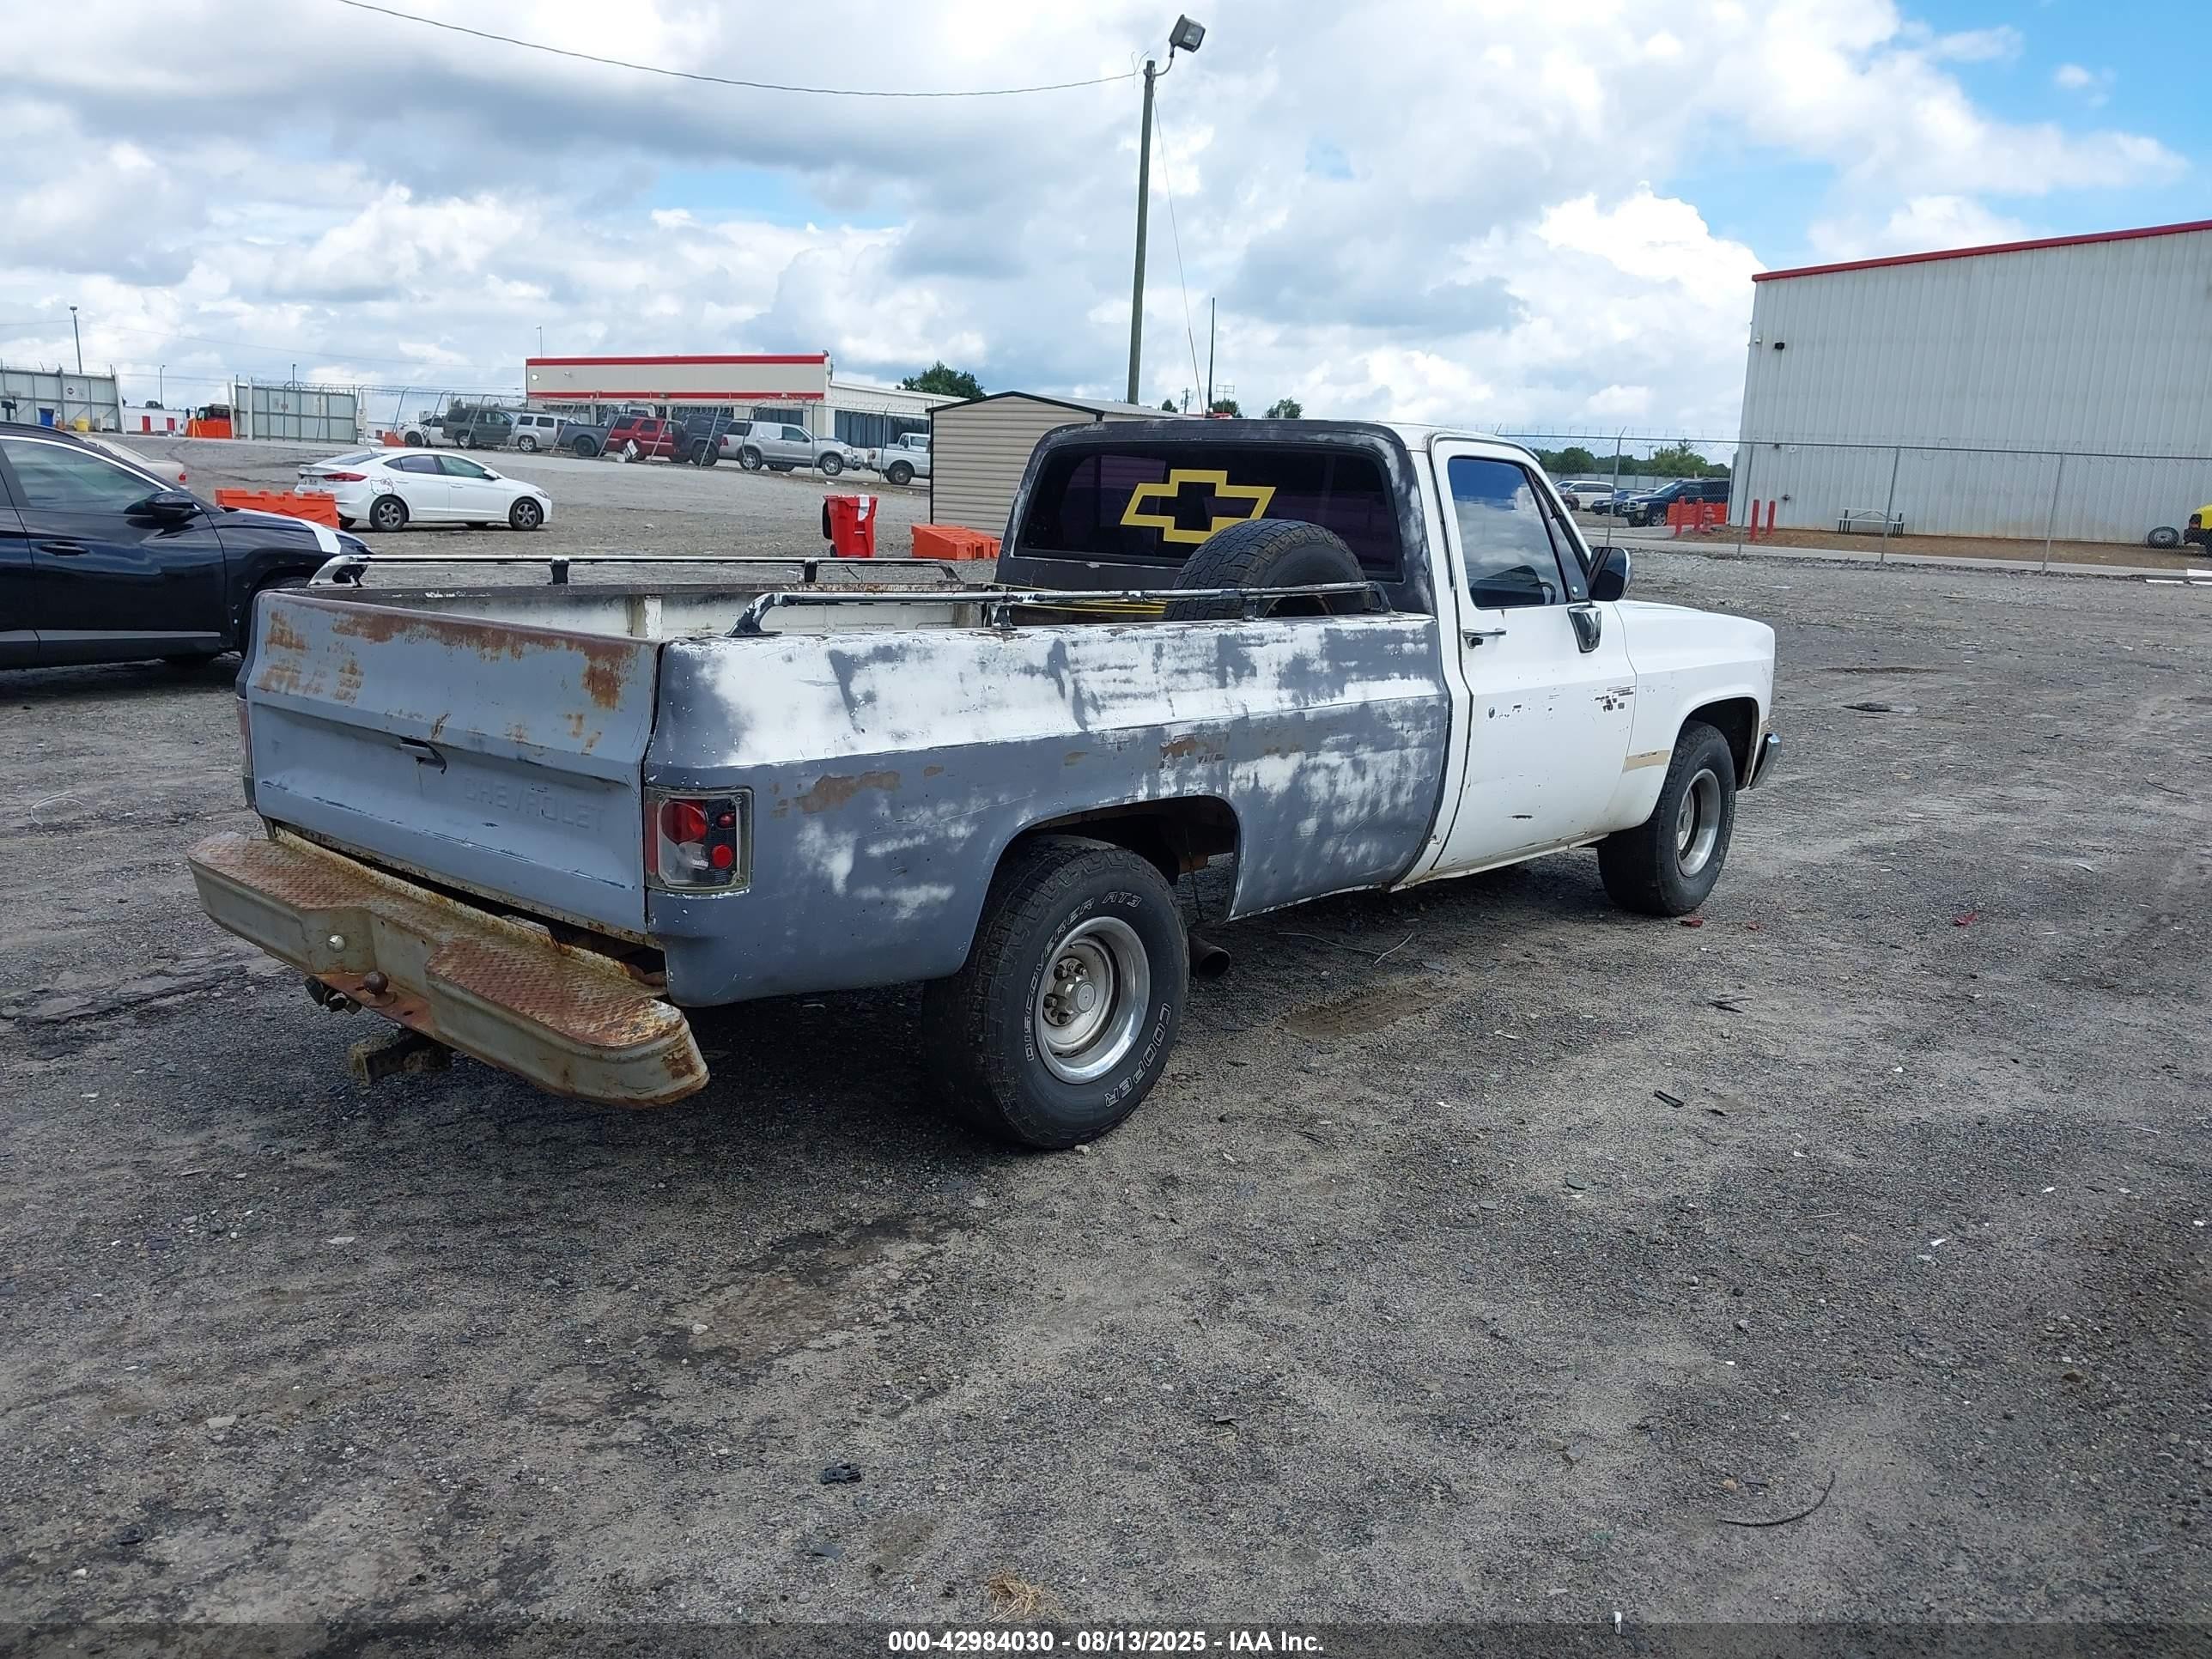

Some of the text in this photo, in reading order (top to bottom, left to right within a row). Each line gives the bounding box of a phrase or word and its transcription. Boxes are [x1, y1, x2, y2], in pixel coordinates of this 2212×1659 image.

[1024, 891, 1140, 1061] DISCOVERER AT3
[1104, 1002, 1172, 1108] COOPER
